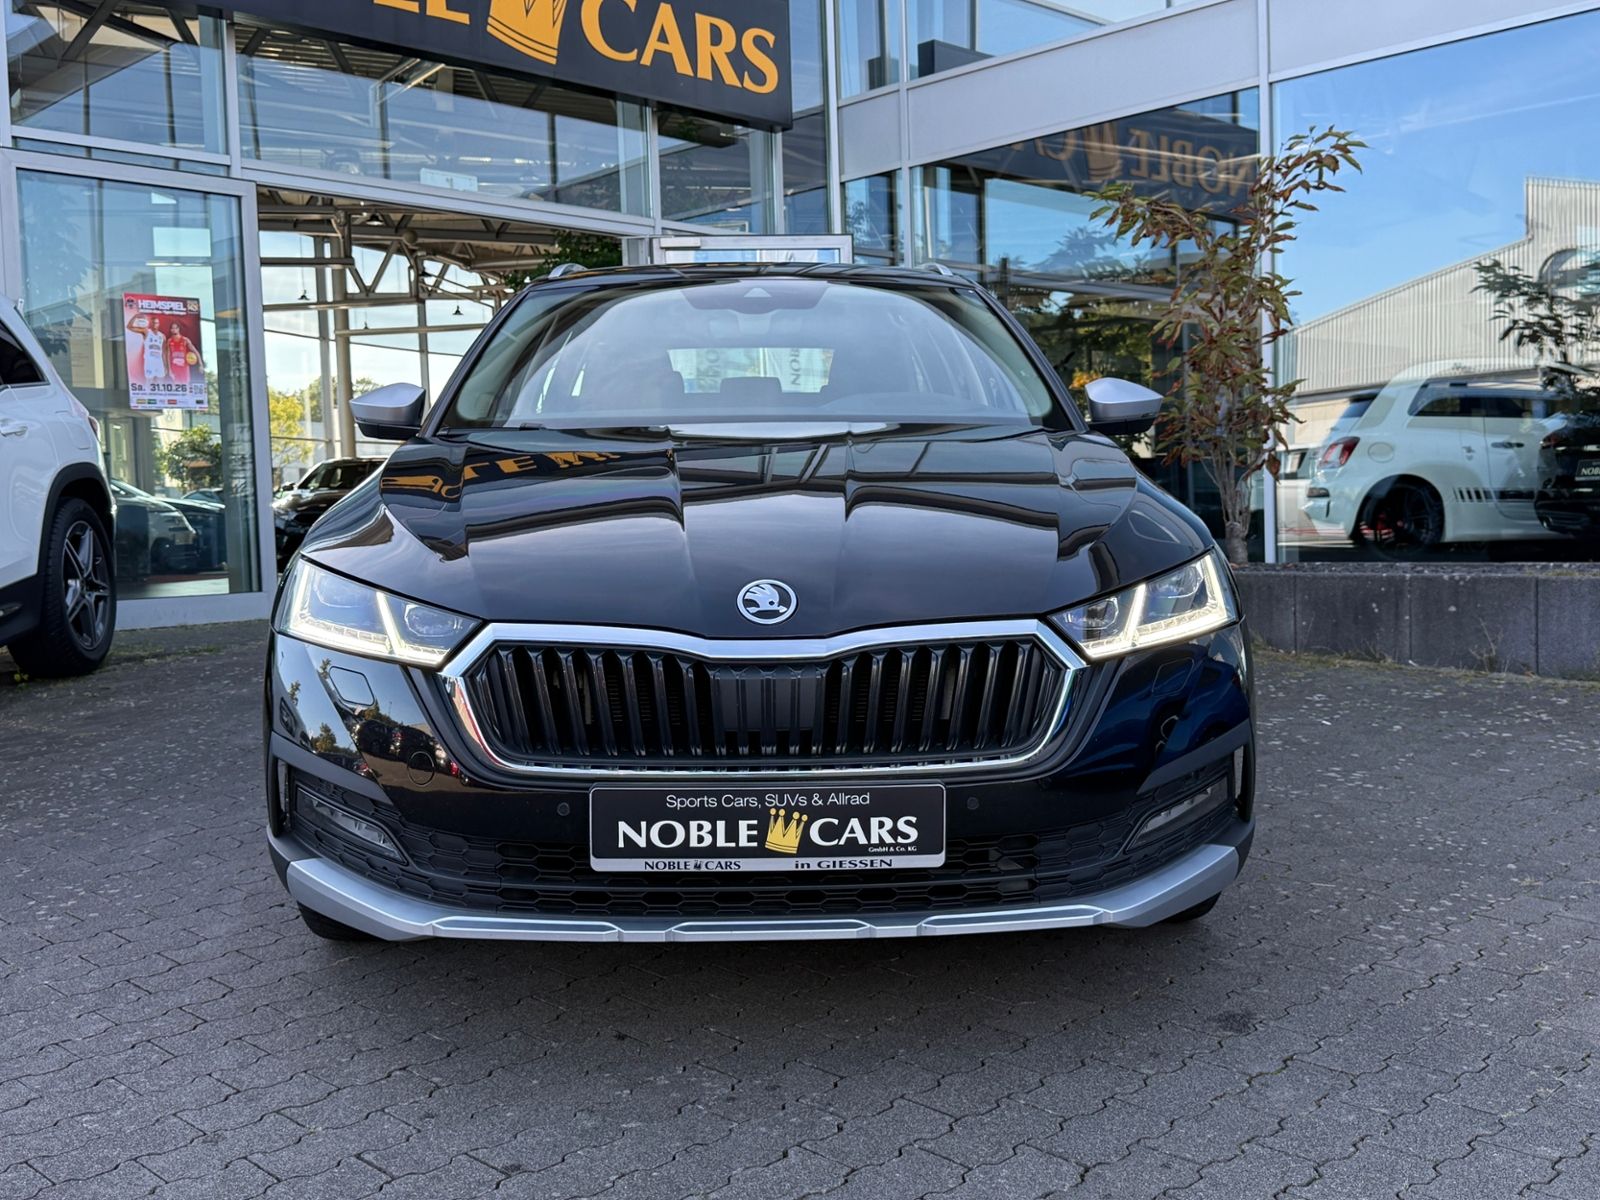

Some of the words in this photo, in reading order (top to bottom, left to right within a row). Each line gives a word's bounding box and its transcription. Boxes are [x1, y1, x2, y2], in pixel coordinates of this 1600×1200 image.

[580, 0, 780, 95] CARS
[138, 299, 187, 311] HEIMSPIEL
[131, 383, 146, 392] Sa.
[666, 794, 718, 810] Sports
[721, 794, 761, 809] Cars,
[764, 793, 808, 807] SUVs
[811, 793, 824, 806] &
[826, 792, 870, 806] Allrad
[617, 819, 759, 848] NOBLE
[809, 816, 919, 846] CARS
[644, 860, 691, 871] NOBLE
[704, 860, 742, 871] CARS
[795, 860, 811, 870] in
[817, 859, 893, 870] GIESSEN
